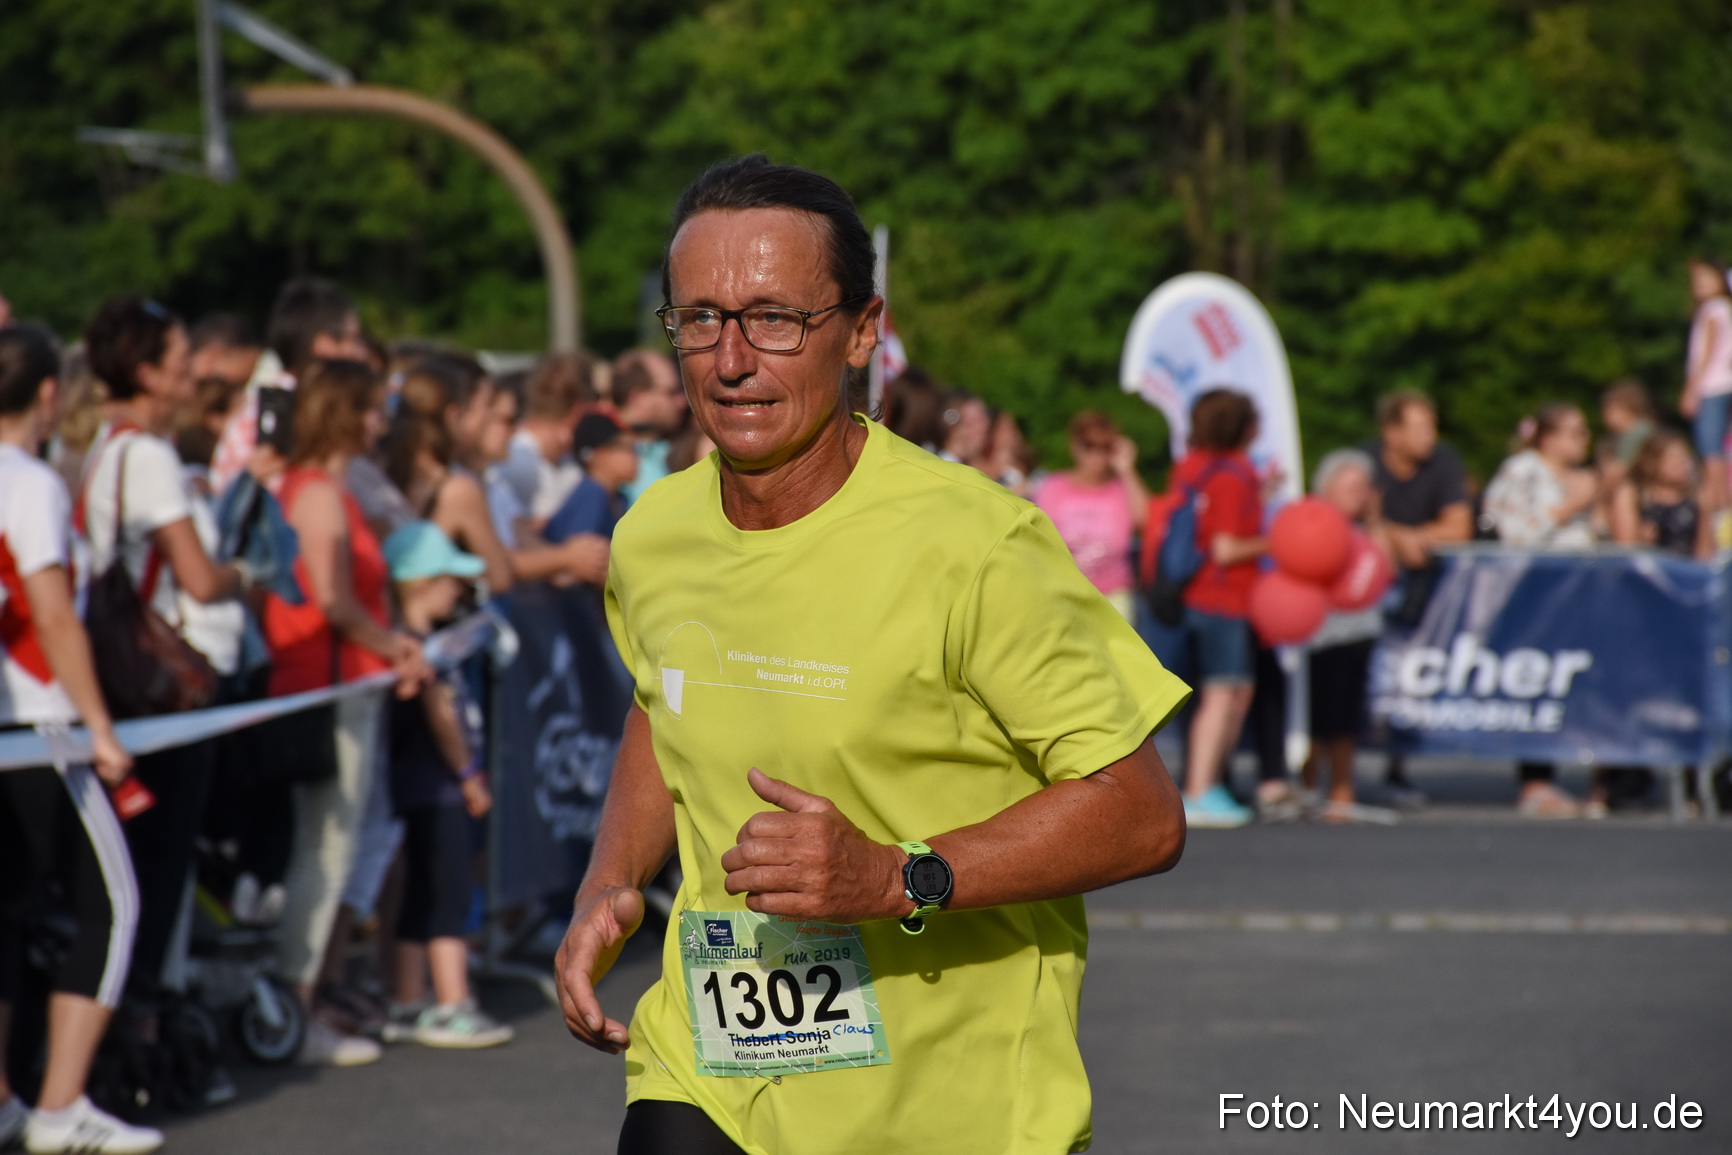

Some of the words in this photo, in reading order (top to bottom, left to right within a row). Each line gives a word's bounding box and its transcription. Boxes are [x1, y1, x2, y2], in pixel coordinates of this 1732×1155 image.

[727, 650, 767, 664] Kliniken
[769, 655, 786, 666] des
[787, 656, 850, 674] Landkreises
[756, 668, 804, 685] Neumarkt
[699, 942, 763, 959] firmenlauf
[814, 947, 851, 963] 2019
[703, 964, 850, 1030] 1302
[727, 1032, 784, 1048] Thebert
[785, 1027, 832, 1044] Sonja
[832, 1023, 876, 1036] Claus
[734, 1049, 776, 1061] Klinikum
[777, 1044, 830, 1059] Neumarkt
